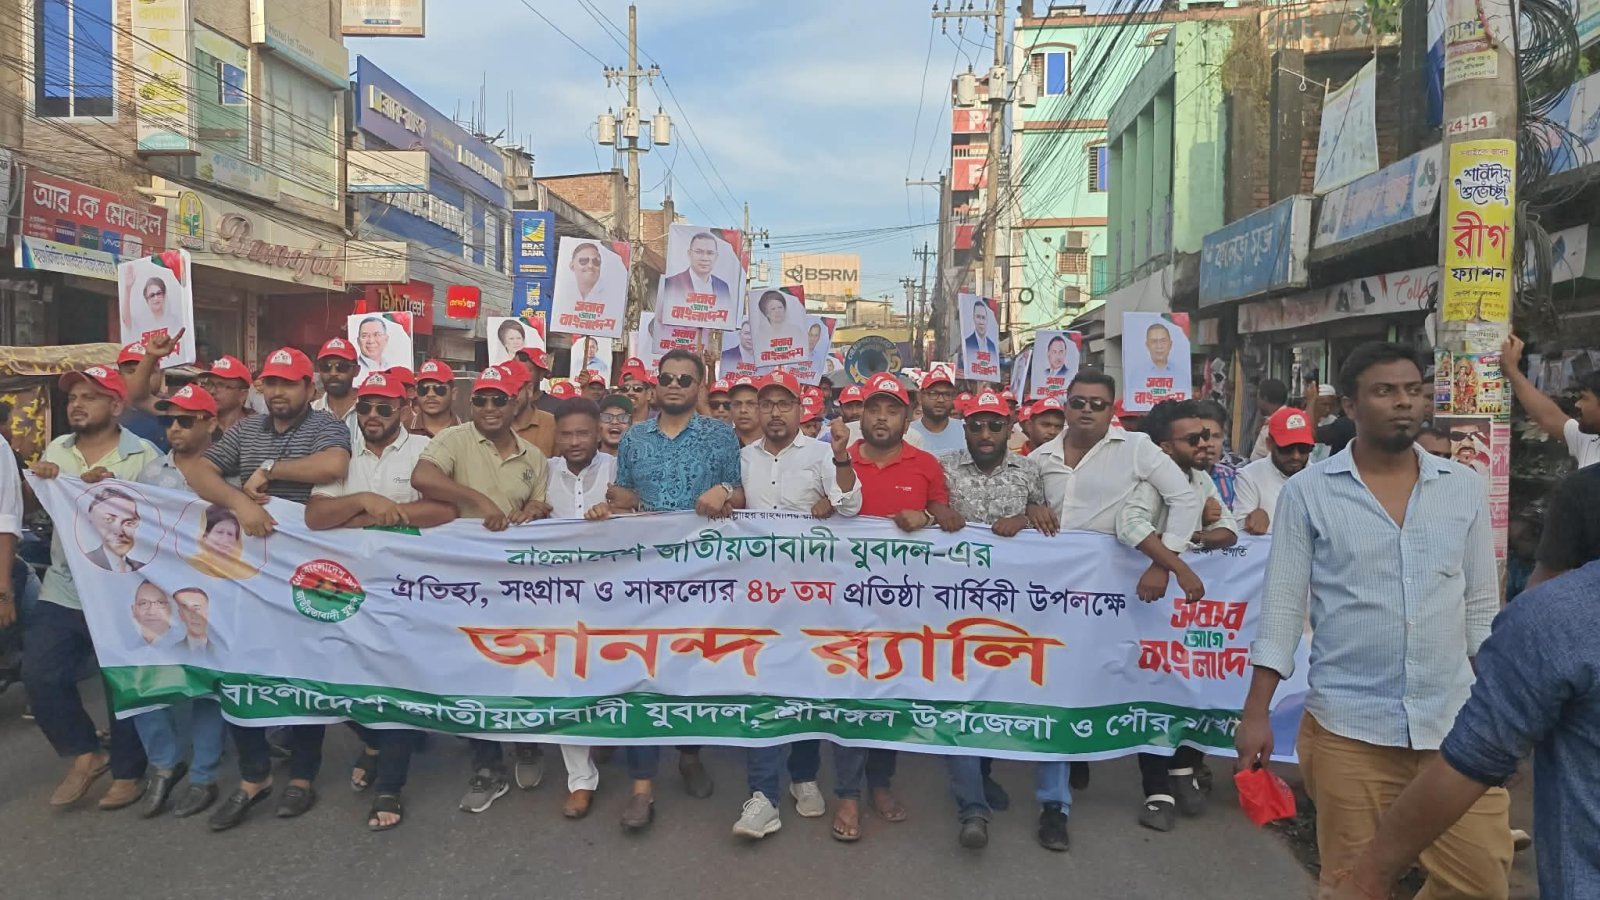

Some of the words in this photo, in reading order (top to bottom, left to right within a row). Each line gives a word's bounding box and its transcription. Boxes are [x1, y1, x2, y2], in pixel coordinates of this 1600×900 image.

[1448, 116, 1488, 132] 24-14
[105, 200, 162, 236] মোবাইল
[1452, 211, 1510, 260] রীগ
[804, 268, 858, 282] BSRM
[1451, 267, 1506, 282] ফ্যাশন
[687, 292, 717, 308] সবার
[575, 301, 605, 317] সবার
[672, 306, 728, 323] বাংলাদেশ
[560, 314, 615, 331] বাংলাদেশ
[770, 337, 793, 348] সবার
[761, 348, 803, 361] বাংলাদেশ
[1146, 377, 1173, 391] সবার
[653, 526, 840, 564] জাতীয়তাবাদী
[848, 534, 993, 571] যুবদল-এর
[391, 574, 488, 609] ঐতিহ্য,
[499, 577, 585, 606] সংগ্রাম
[596, 578, 613, 603] ও
[624, 579, 738, 604] সাফল্যের
[747, 580, 786, 603] ৪৮
[791, 580, 836, 606] তম
[843, 574, 924, 609] প্রতিষ্ঠা
[932, 578, 1019, 613] বার্ষিকী
[1026, 581, 1126, 617] উপলক্ষে
[1171, 598, 1248, 641] সবার
[1184, 630, 1224, 648] আগে
[457, 620, 781, 680] আনন্দ
[1138, 639, 1253, 681] বাংলাদে
[220, 680, 392, 714] বাংলাদেশ
[396, 698, 634, 730] জাতীয়তাবাদী
[774, 699, 902, 728] শ্রীমঙ্গল
[908, 702, 1057, 740] উপজেলা
[1070, 719, 1093, 738] ও
[1105, 706, 1176, 736] পৌর
